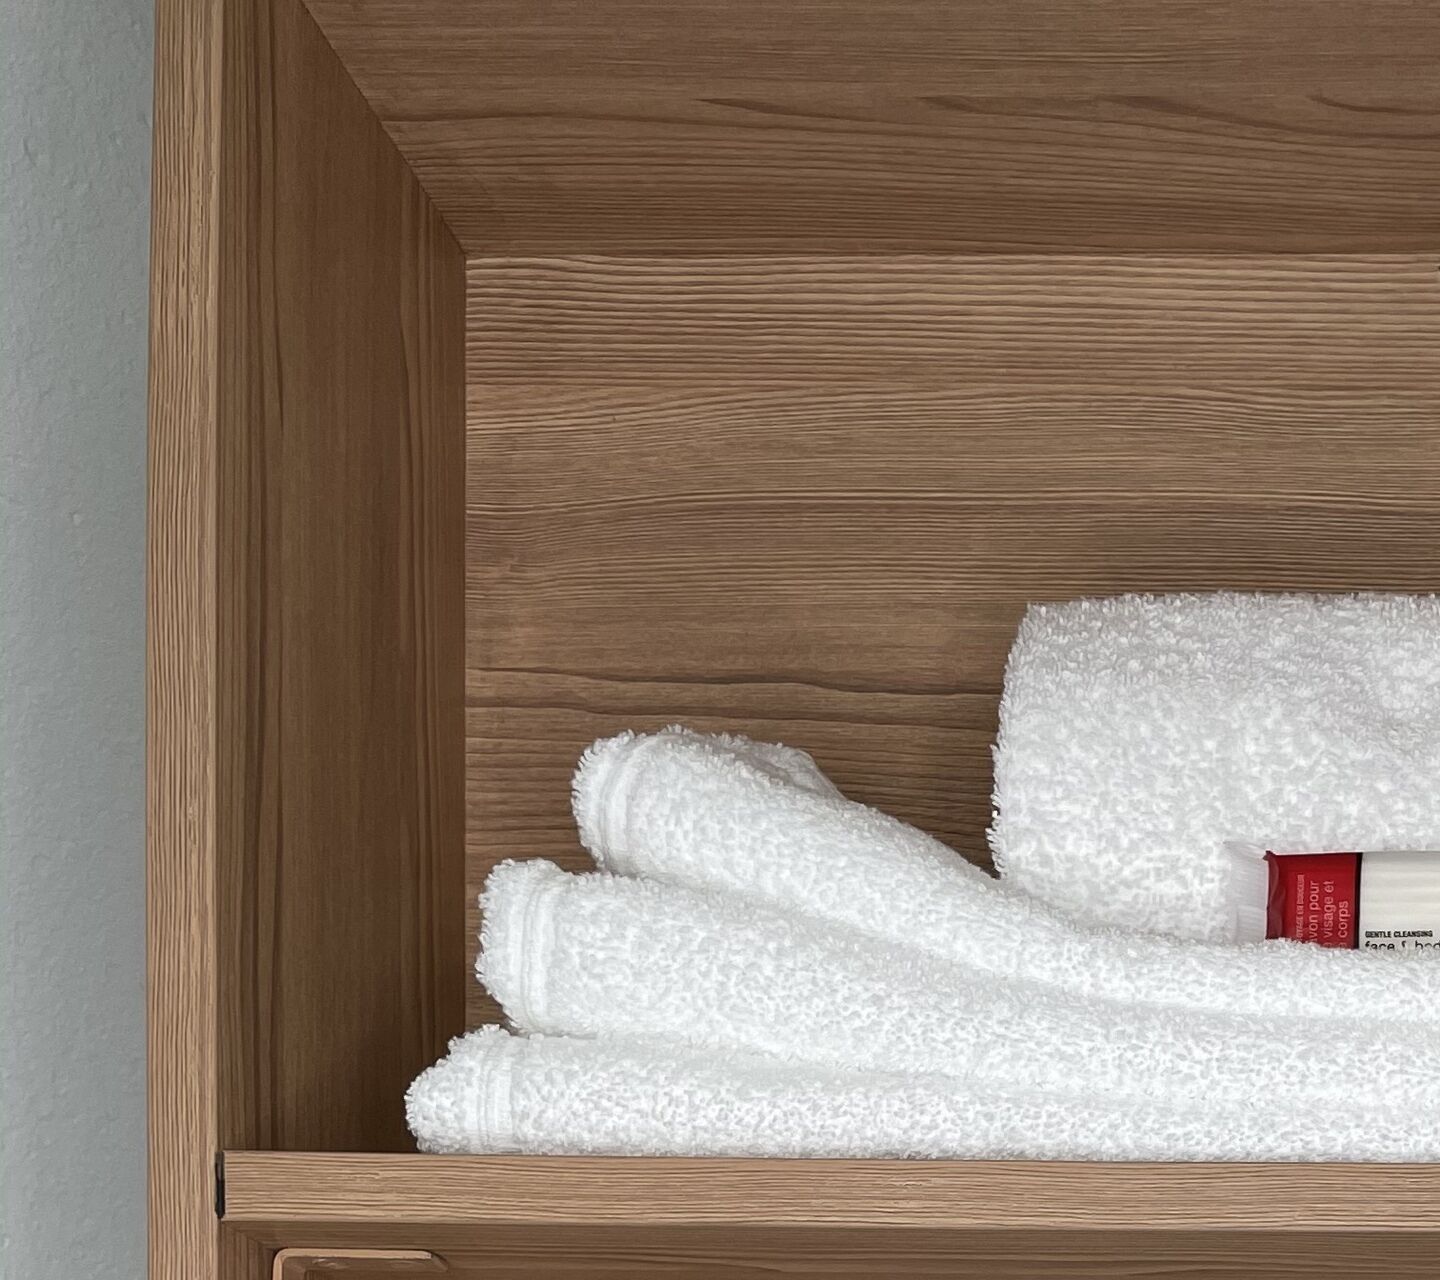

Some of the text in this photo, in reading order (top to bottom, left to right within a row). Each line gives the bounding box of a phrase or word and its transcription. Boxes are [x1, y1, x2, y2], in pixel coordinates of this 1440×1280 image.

[1309, 880, 1322, 911] pour
[1323, 880, 1334, 893] et
[1321, 896, 1337, 939] visage
[1338, 901, 1351, 938] corps
[1364, 930, 1434, 939] GENTLE CLEANSING
